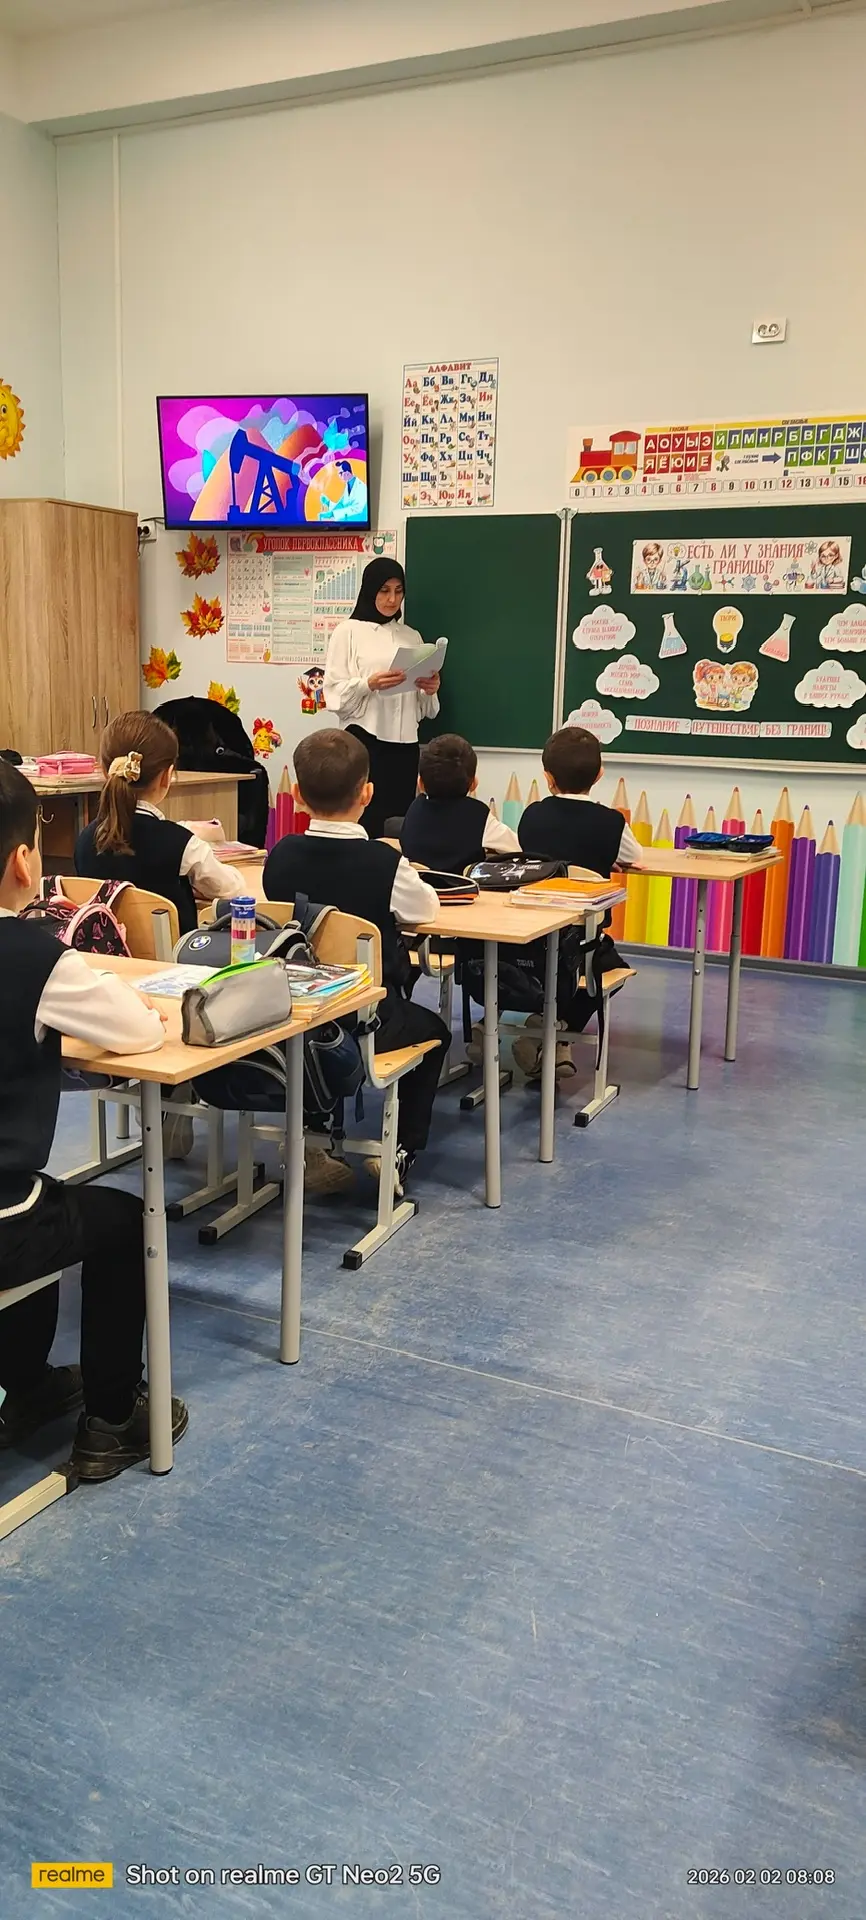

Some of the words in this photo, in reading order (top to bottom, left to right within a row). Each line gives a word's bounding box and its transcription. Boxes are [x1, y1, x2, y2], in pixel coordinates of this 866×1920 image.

[428, 363, 472, 373] АЛФАВИТ
[646, 439, 655, 449] А
[660, 438, 669, 448] О
[675, 437, 683, 448] У
[687, 437, 698, 447] Ы
[702, 436, 711, 446] Э
[717, 433, 725, 445] Й
[730, 434, 739, 445] Л
[744, 434, 754, 444] М
[760, 433, 768, 443] Н
[775, 432, 782, 442] Р
[789, 431, 798, 441] Б
[804, 430, 813, 440] В
[820, 429, 827, 439] Г
[834, 428, 843, 441] Д
[848, 427, 861, 438] Ж
[788, 452, 797, 462] П
[801, 451, 812, 461] Ф
[818, 450, 826, 460] К
[833, 449, 842, 459] Т
[846, 448, 859, 458] Ш
[646, 459, 654, 469] Я
[660, 456, 667, 468] Ё
[672, 457, 683, 467] Ю
[687, 457, 695, 467] И
[702, 456, 708, 466] Е
[592, 488, 595, 496] 1
[659, 485, 663, 493] 5
[676, 484, 681, 492] 6
[711, 483, 716, 491] 8
[745, 481, 755, 489] 10
[763, 481, 772, 489] 11
[782, 480, 792, 488] 12
[800, 479, 810, 487] 13
[819, 478, 829, 486] 14
[839, 477, 849, 485] 15
[263, 537, 290, 550] УГОЛОК
[292, 536, 358, 549] ПЕРВОКЛАССНИКА
[687, 544, 714, 559] ЕСТЬ
[720, 544, 737, 558] ЛИ
[743, 544, 752, 558] У
[758, 544, 804, 558] ЗНАНИЯ
[713, 560, 775, 575] ГРАНИЦЫ?
[635, 719, 680, 732] ПОЗНАНИЕ
[693, 721, 759, 735] ПУТЕШЕСТВИЕ
[766, 724, 781, 735] БЕЗ
[786, 724, 827, 736] ГРАНИЦ!
